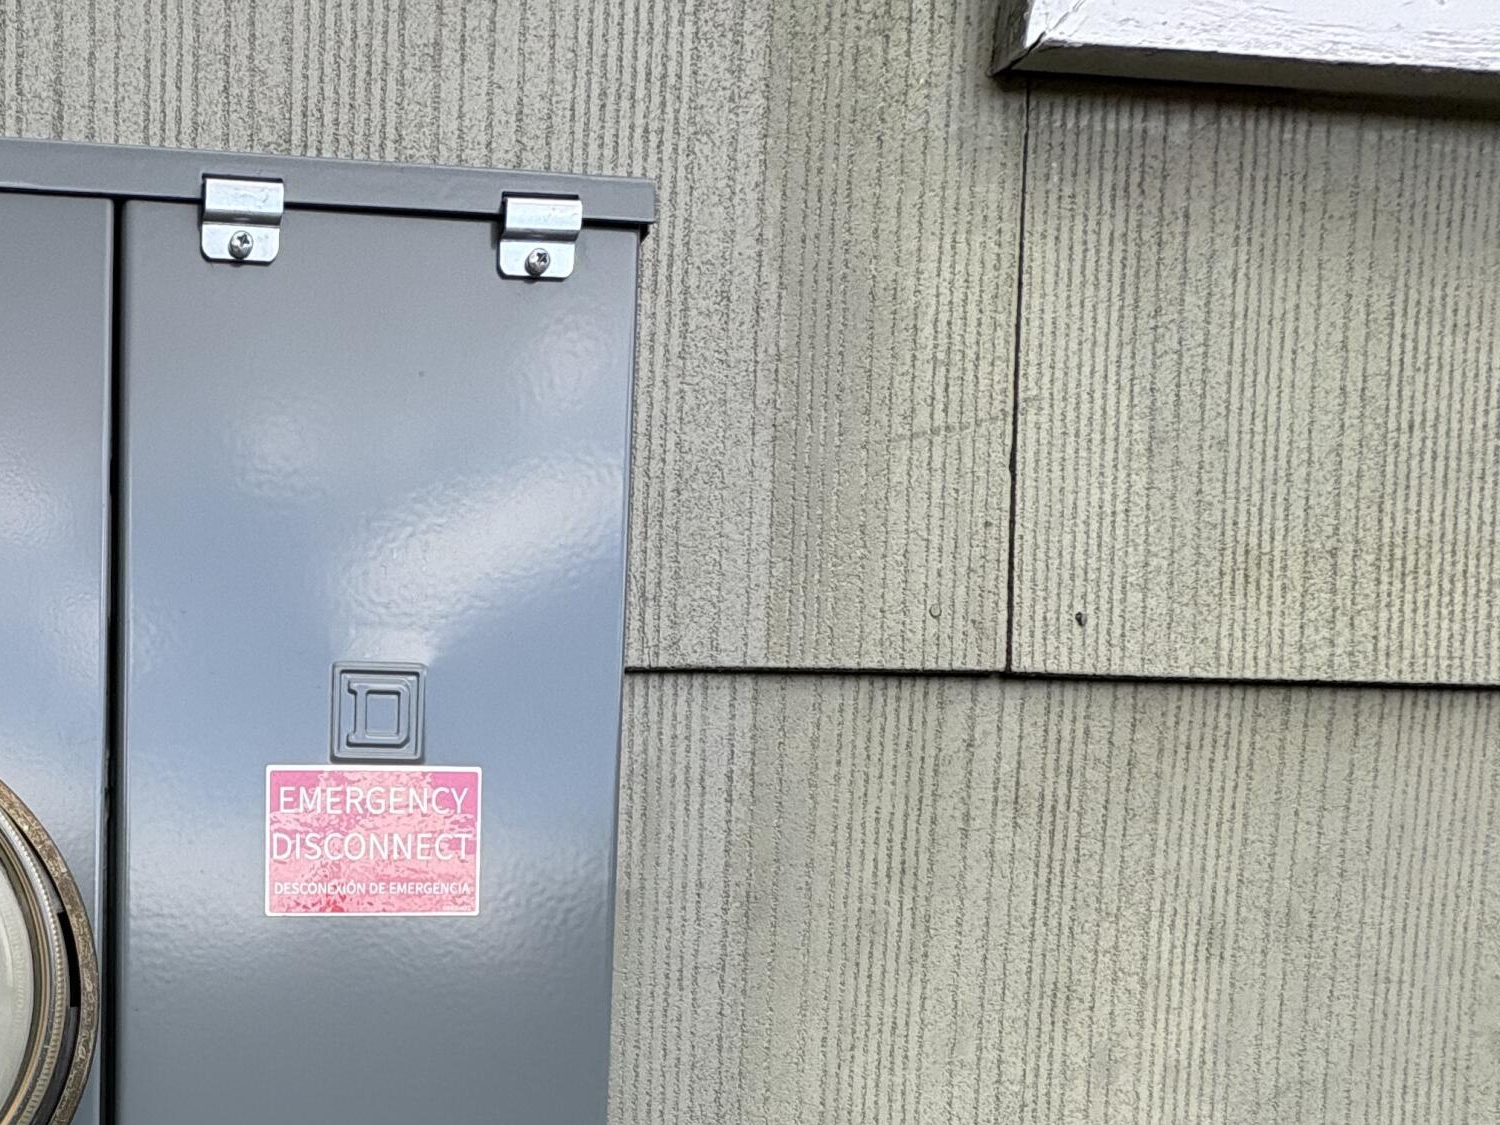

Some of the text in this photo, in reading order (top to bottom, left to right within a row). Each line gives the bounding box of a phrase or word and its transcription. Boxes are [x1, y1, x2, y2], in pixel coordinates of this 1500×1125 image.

[279, 785, 469, 815] EMERGENCY
[272, 832, 472, 861] DISCONNECT
[274, 880, 471, 895] DESCONEXIÓN DE EMERGENCIA
